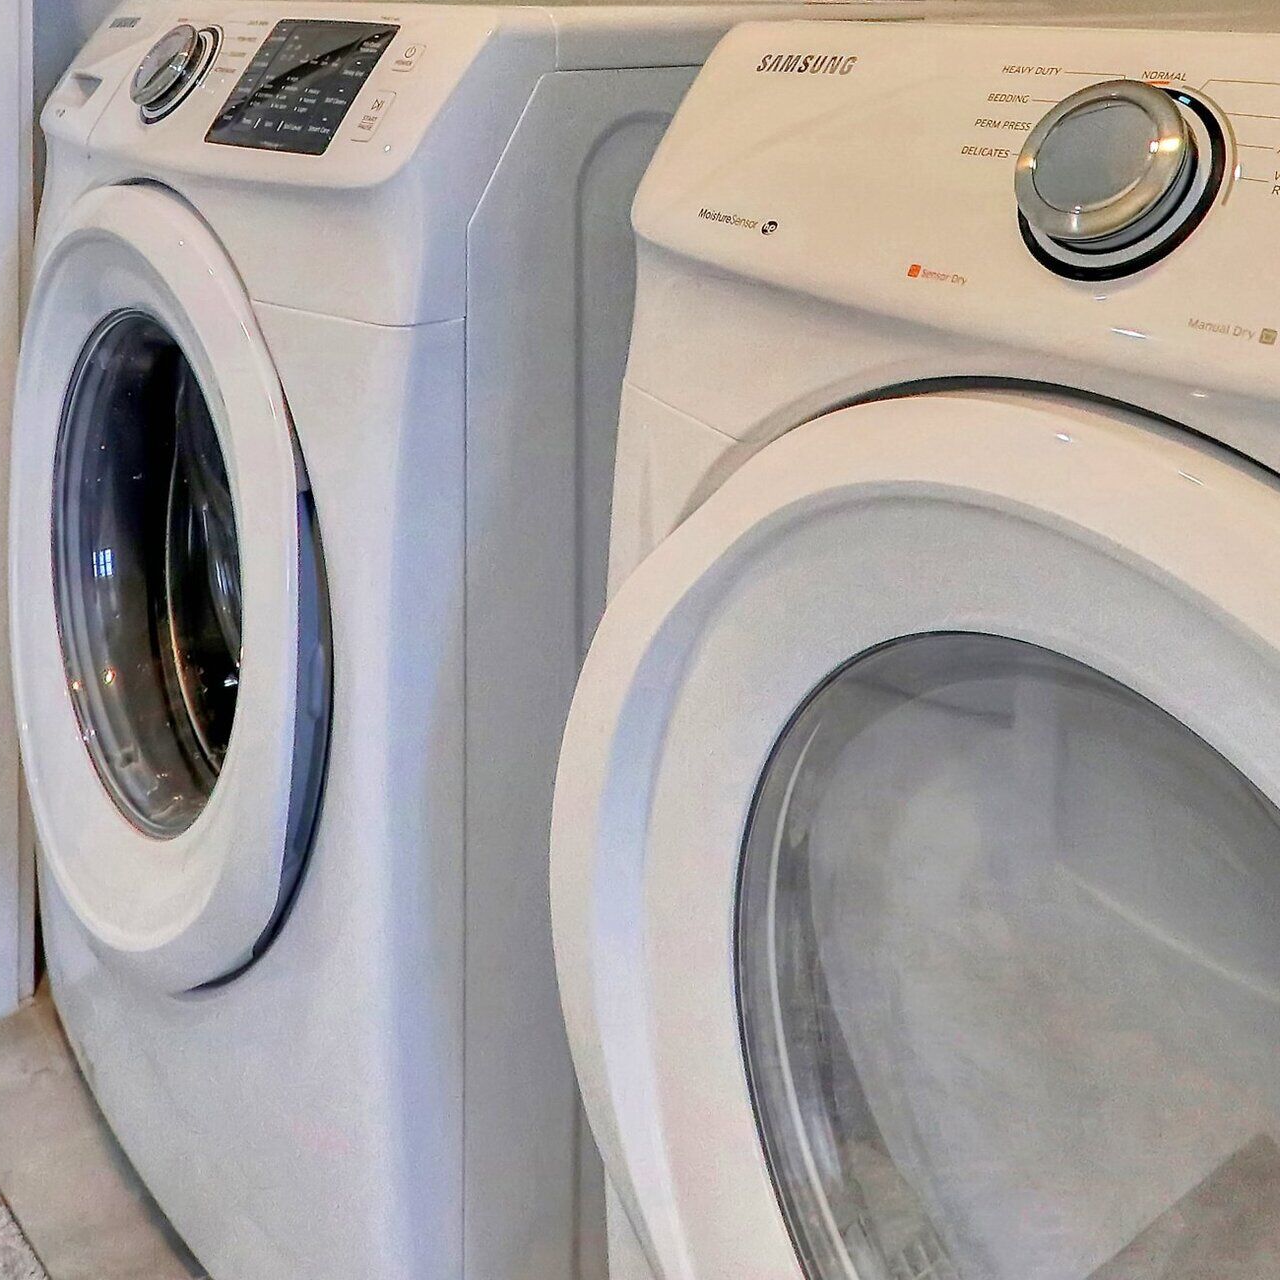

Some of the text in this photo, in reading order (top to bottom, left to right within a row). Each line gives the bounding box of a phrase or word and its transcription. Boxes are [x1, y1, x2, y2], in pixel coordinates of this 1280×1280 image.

[756, 54, 858, 75] SAMSUNG
[1002, 65, 1063, 76] HEAVY DUTY
[1141, 71, 1187, 82] NORMAL
[987, 93, 1030, 104] BEDDING
[974, 118, 1032, 131] PERM PRESS
[961, 145, 1010, 158] DELICATES
[698, 208, 759, 229] MoistureSensor
[951, 274, 967, 285] Dry
[1187, 318, 1256, 339] Manual Dry
